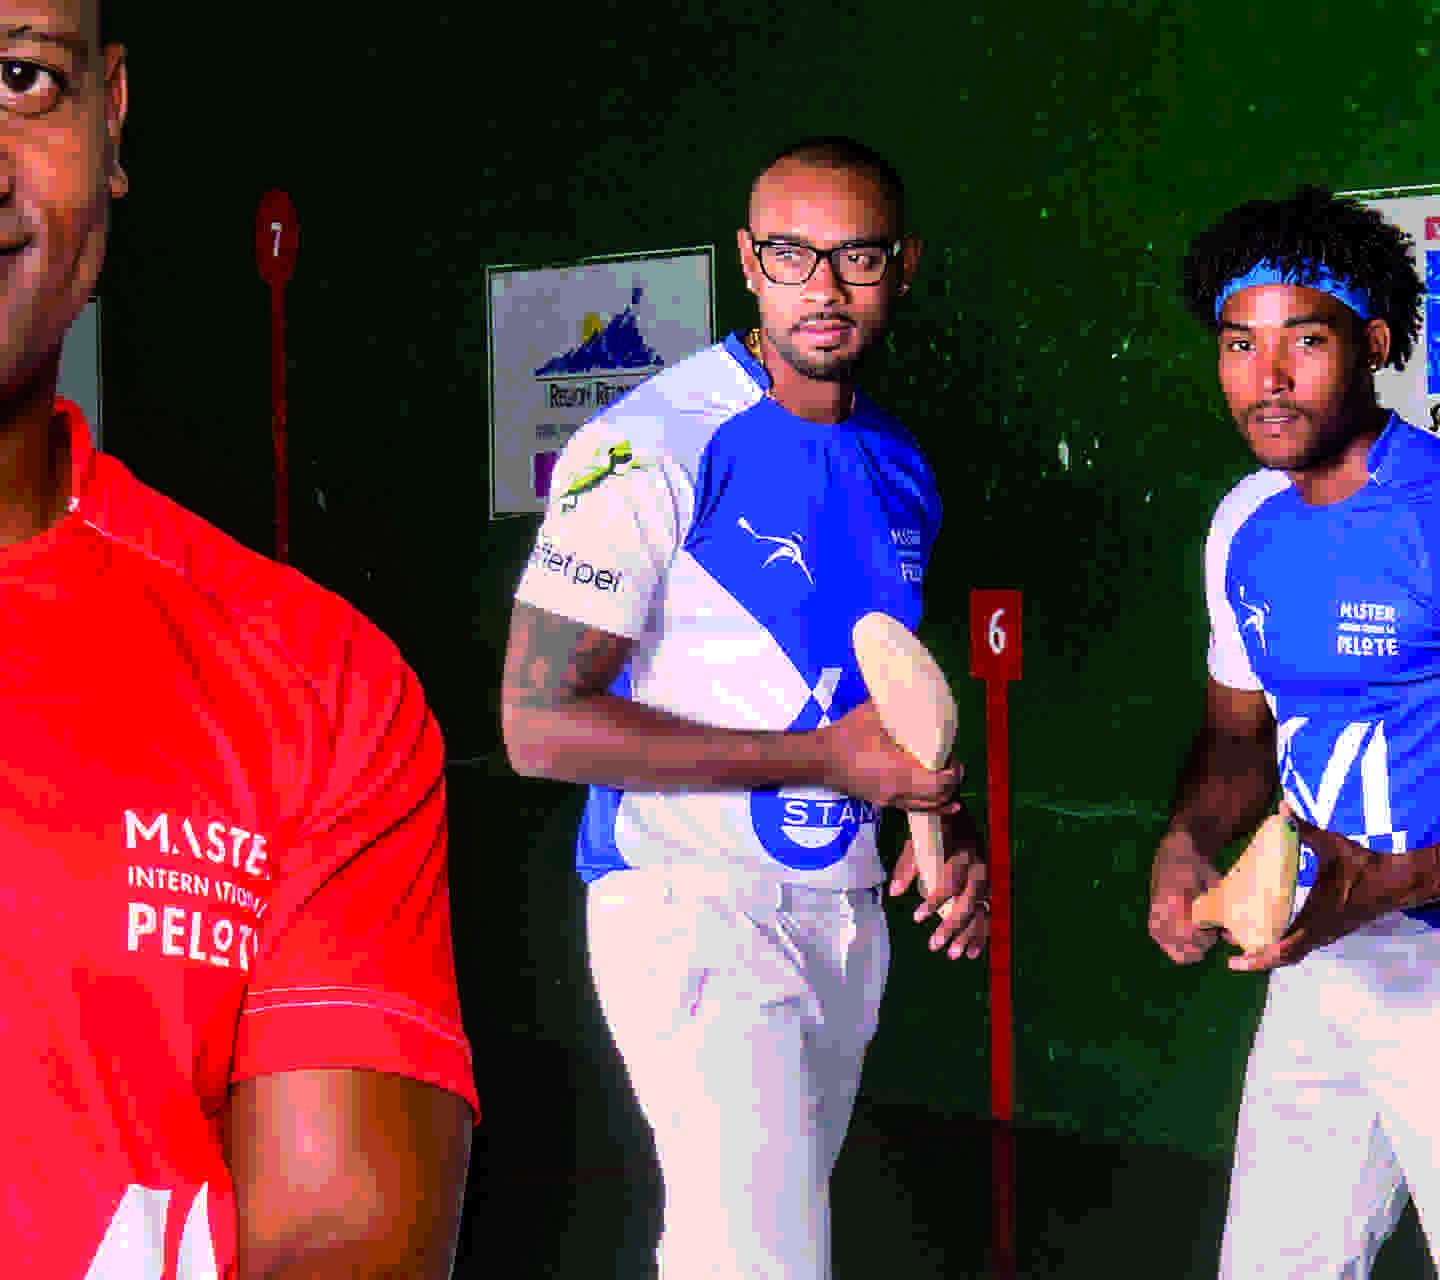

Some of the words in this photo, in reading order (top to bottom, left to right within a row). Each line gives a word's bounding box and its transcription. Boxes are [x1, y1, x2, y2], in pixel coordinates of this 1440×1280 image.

[987, 608, 1007, 655] 6
[123, 809, 269, 878] MASTE
[127, 901, 259, 976] PELOT
